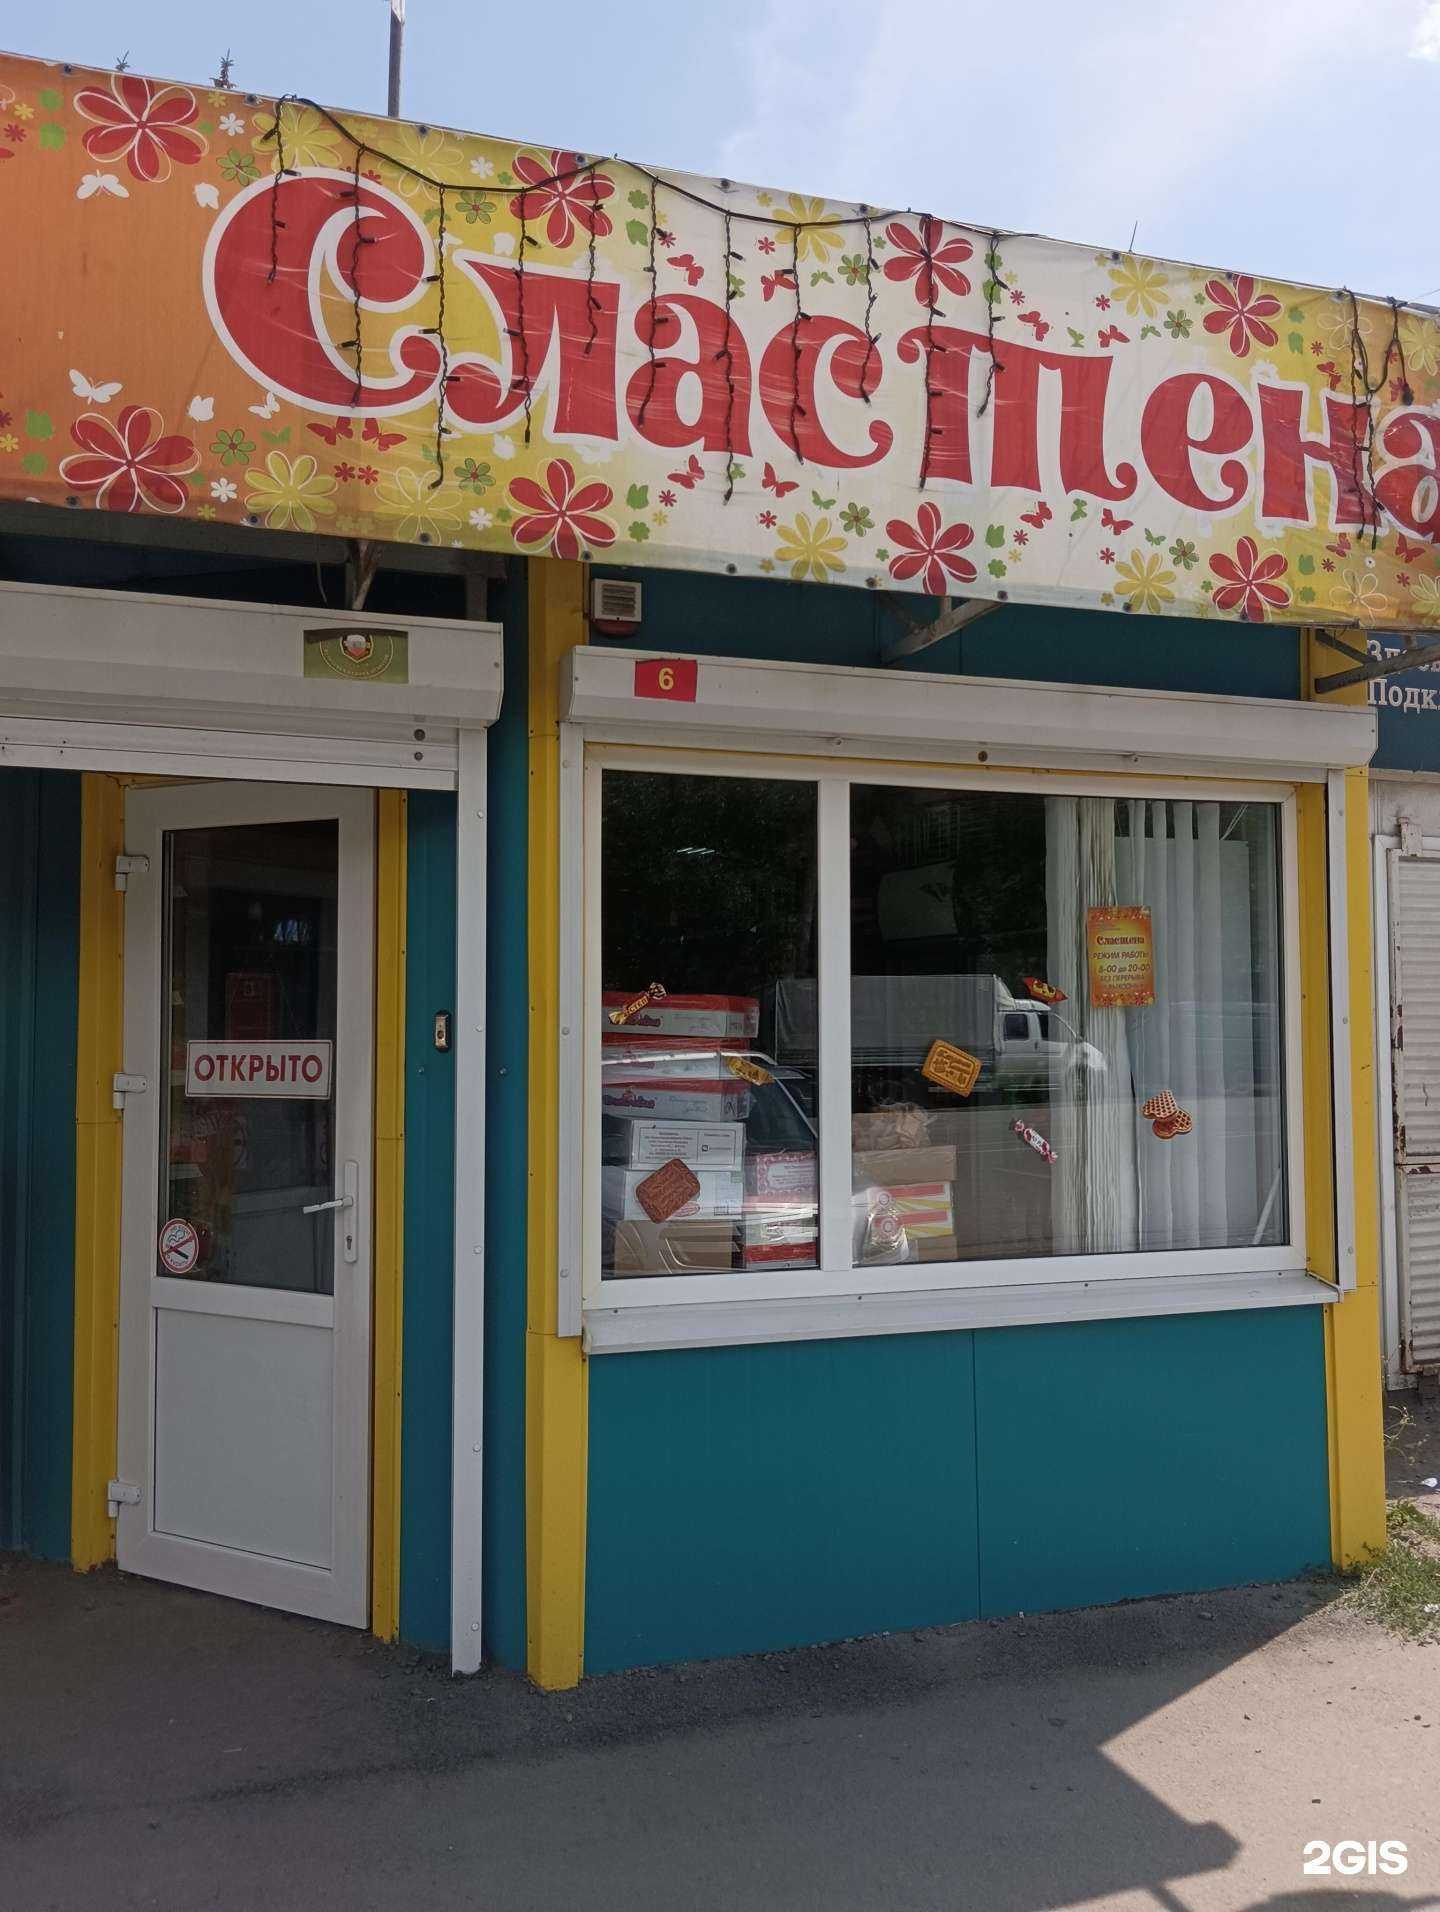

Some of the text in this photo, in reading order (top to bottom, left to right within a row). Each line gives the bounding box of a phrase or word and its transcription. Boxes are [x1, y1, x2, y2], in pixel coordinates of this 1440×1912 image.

[658, 667, 675, 691] 6
[1367, 678, 1440, 715] Подк
[194, 1054, 323, 1083] ОТКРЫТО
